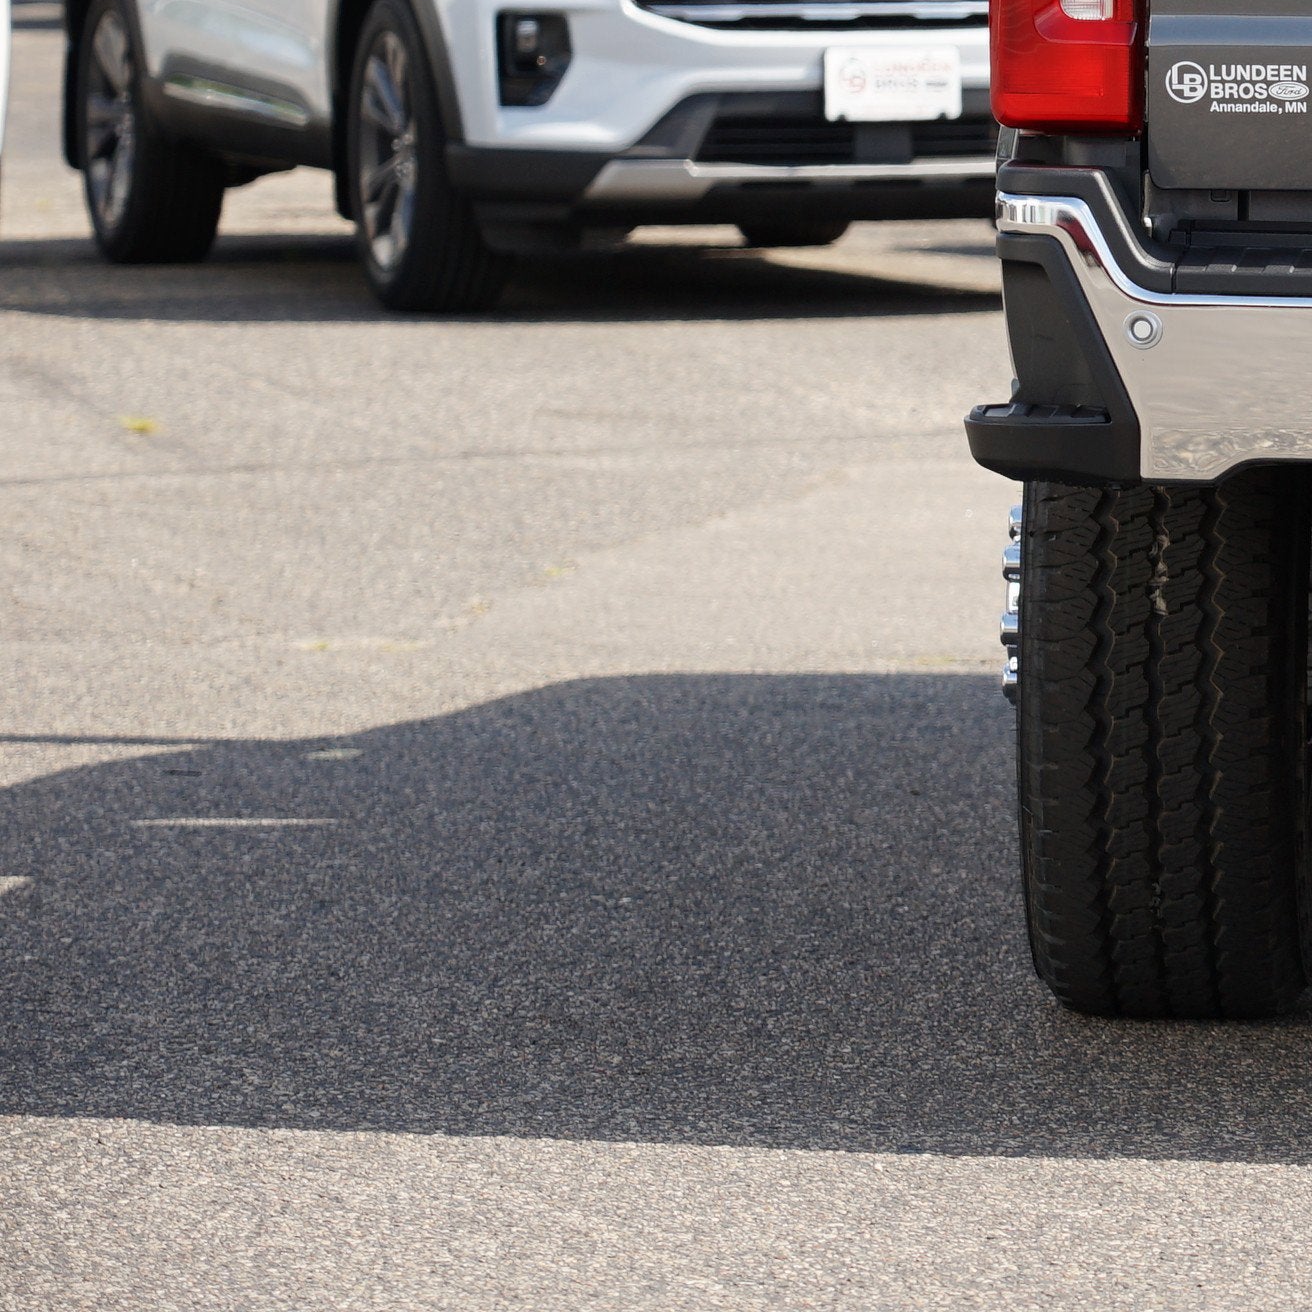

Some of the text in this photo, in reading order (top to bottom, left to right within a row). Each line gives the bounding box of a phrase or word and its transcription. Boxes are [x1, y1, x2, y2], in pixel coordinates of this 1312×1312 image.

[1209, 64, 1307, 82] LUNDEEN
[1209, 82, 1268, 99] BROS
[1209, 101, 1307, 114] Annandale, MN
